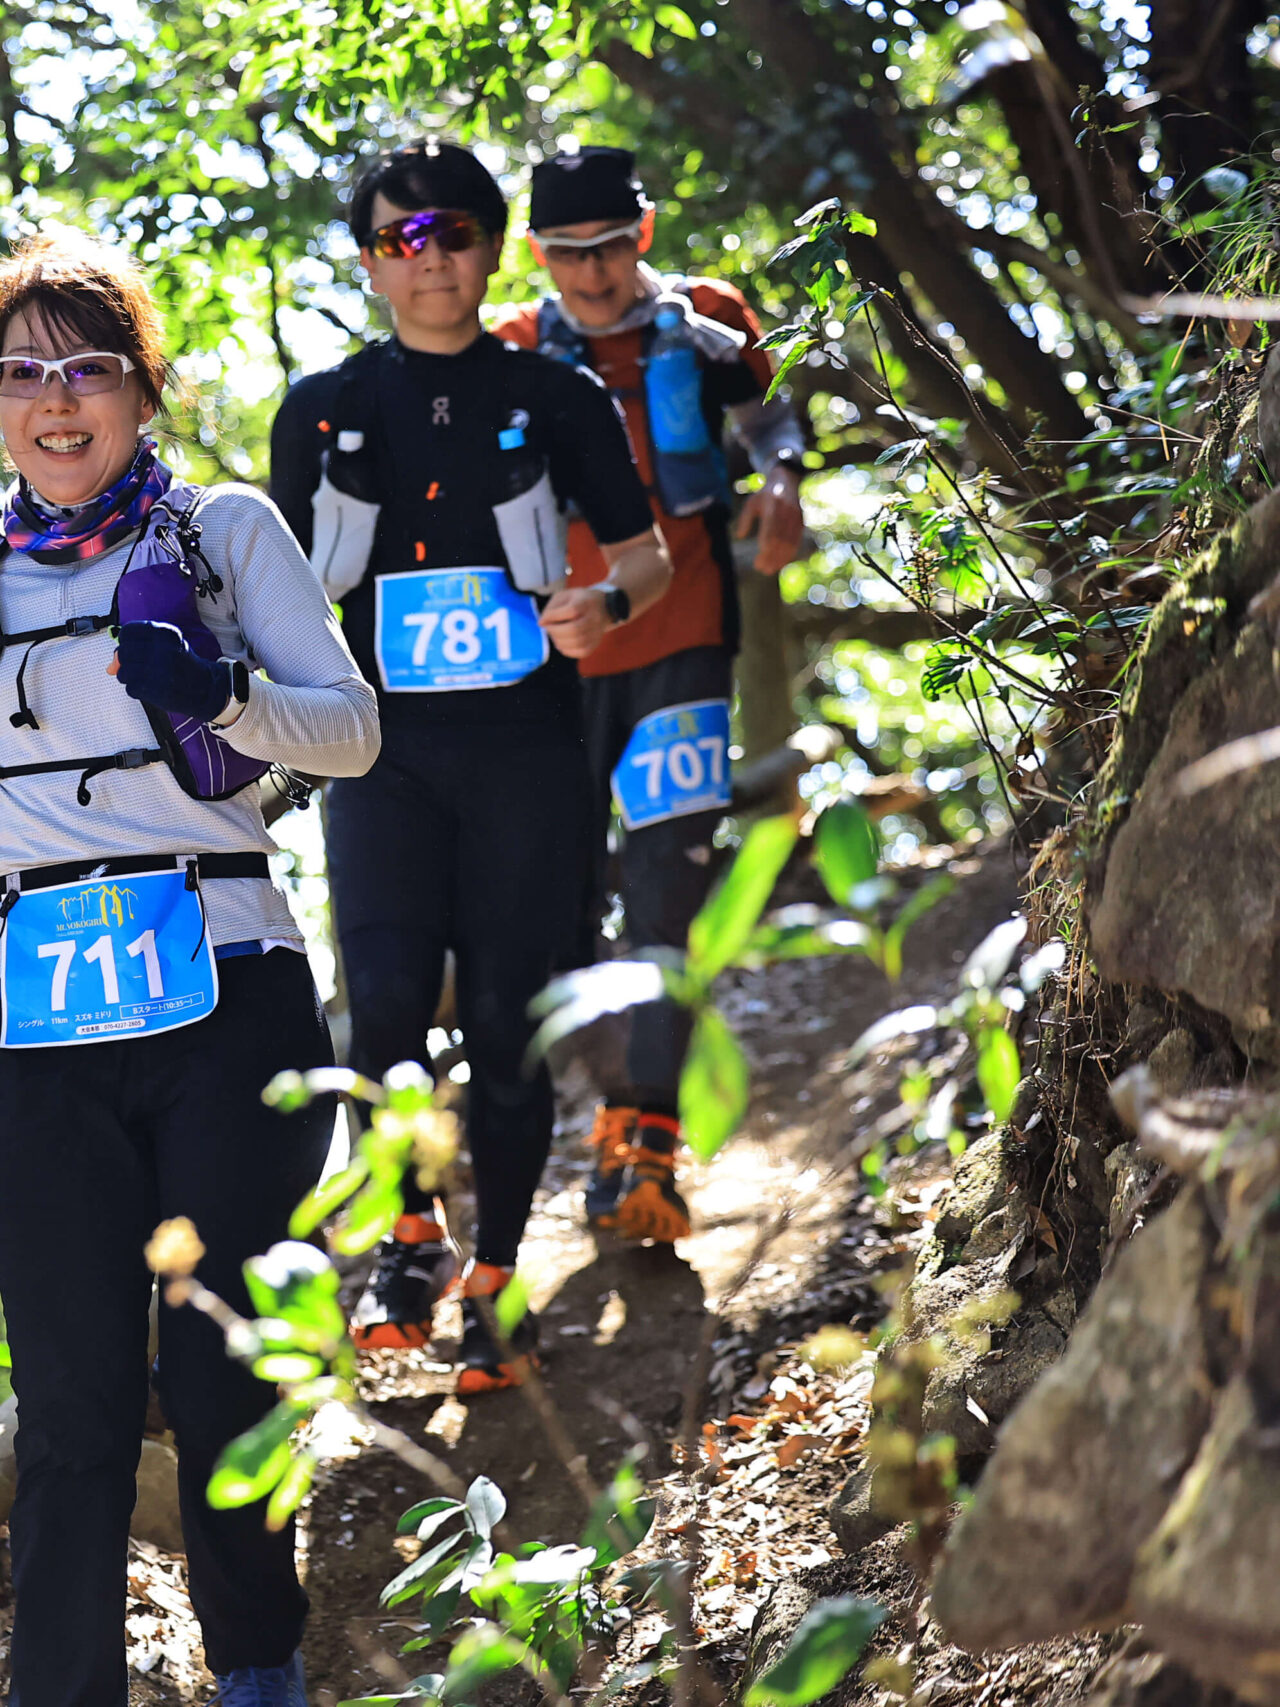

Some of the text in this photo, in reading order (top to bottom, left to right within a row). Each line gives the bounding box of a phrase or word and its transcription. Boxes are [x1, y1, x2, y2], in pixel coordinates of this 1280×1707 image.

[403, 607, 512, 666] 781
[631, 736, 724, 798] 707
[37, 929, 164, 1011] 711
[17, 1019, 44, 1029] シングル
[51, 1017, 68, 1025] 11km
